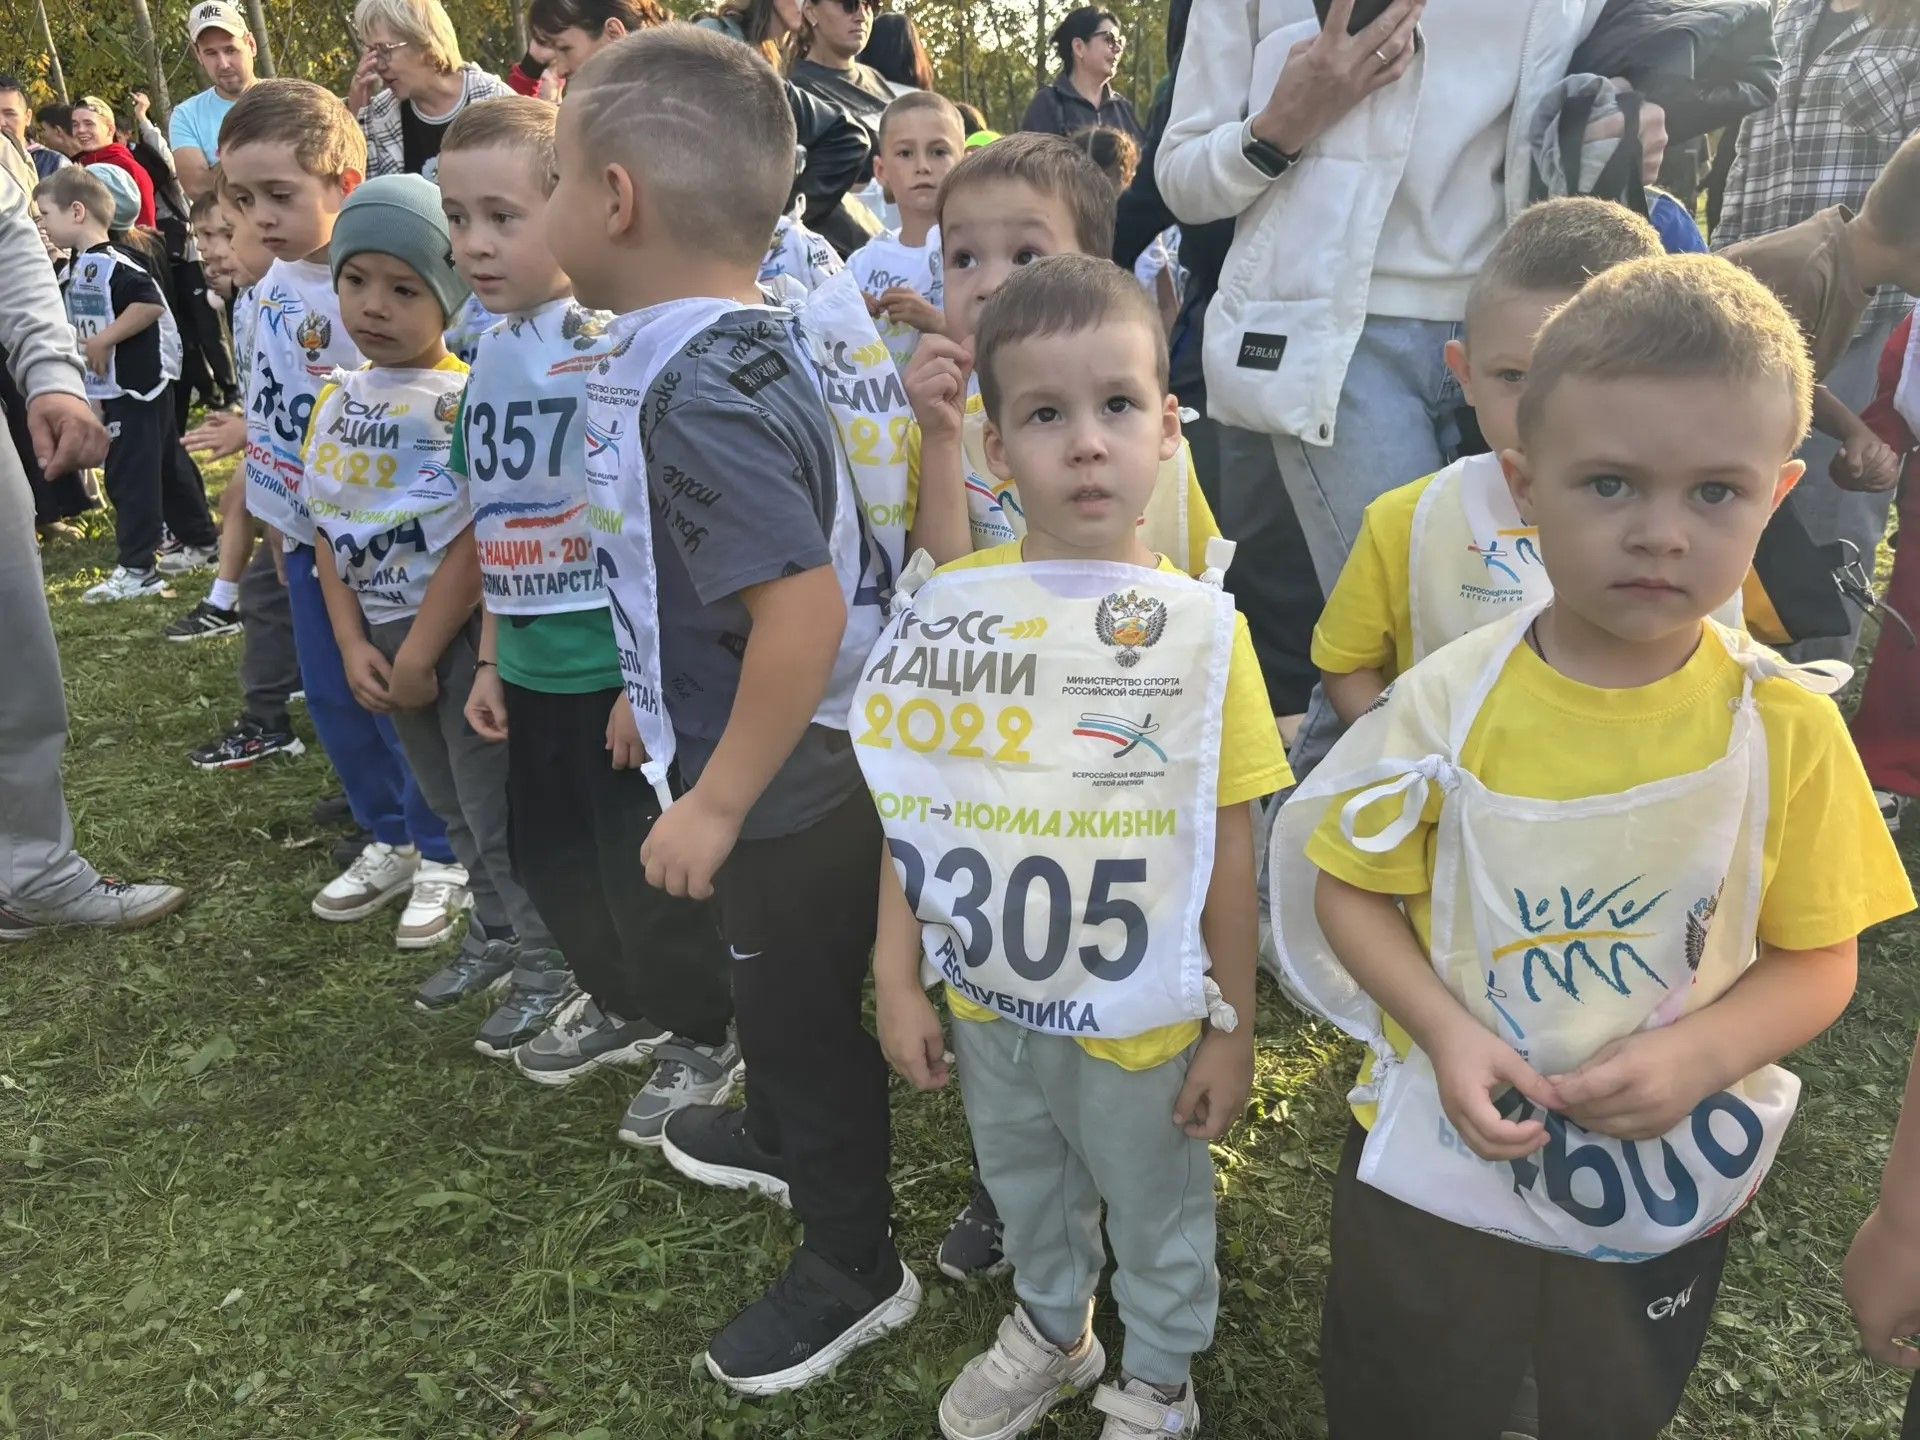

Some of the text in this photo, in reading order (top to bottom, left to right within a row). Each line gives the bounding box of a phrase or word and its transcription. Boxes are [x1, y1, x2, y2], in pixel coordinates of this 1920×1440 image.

[199, 5, 221, 19] NIKE
[485, 539, 544, 571] НАЦИИ
[1062, 686, 1183, 698] РОССИЙСКОЙ ФЕДЕРАЦИИ
[1066, 676, 1180, 687] МИНИСТЕРСТВО СПОРТА
[855, 692, 1033, 763] 2022
[872, 790, 1177, 839] ОРТ НОРМА ЖИЗНИ
[935, 936, 1101, 1032] РЕСПУБЛИКА
